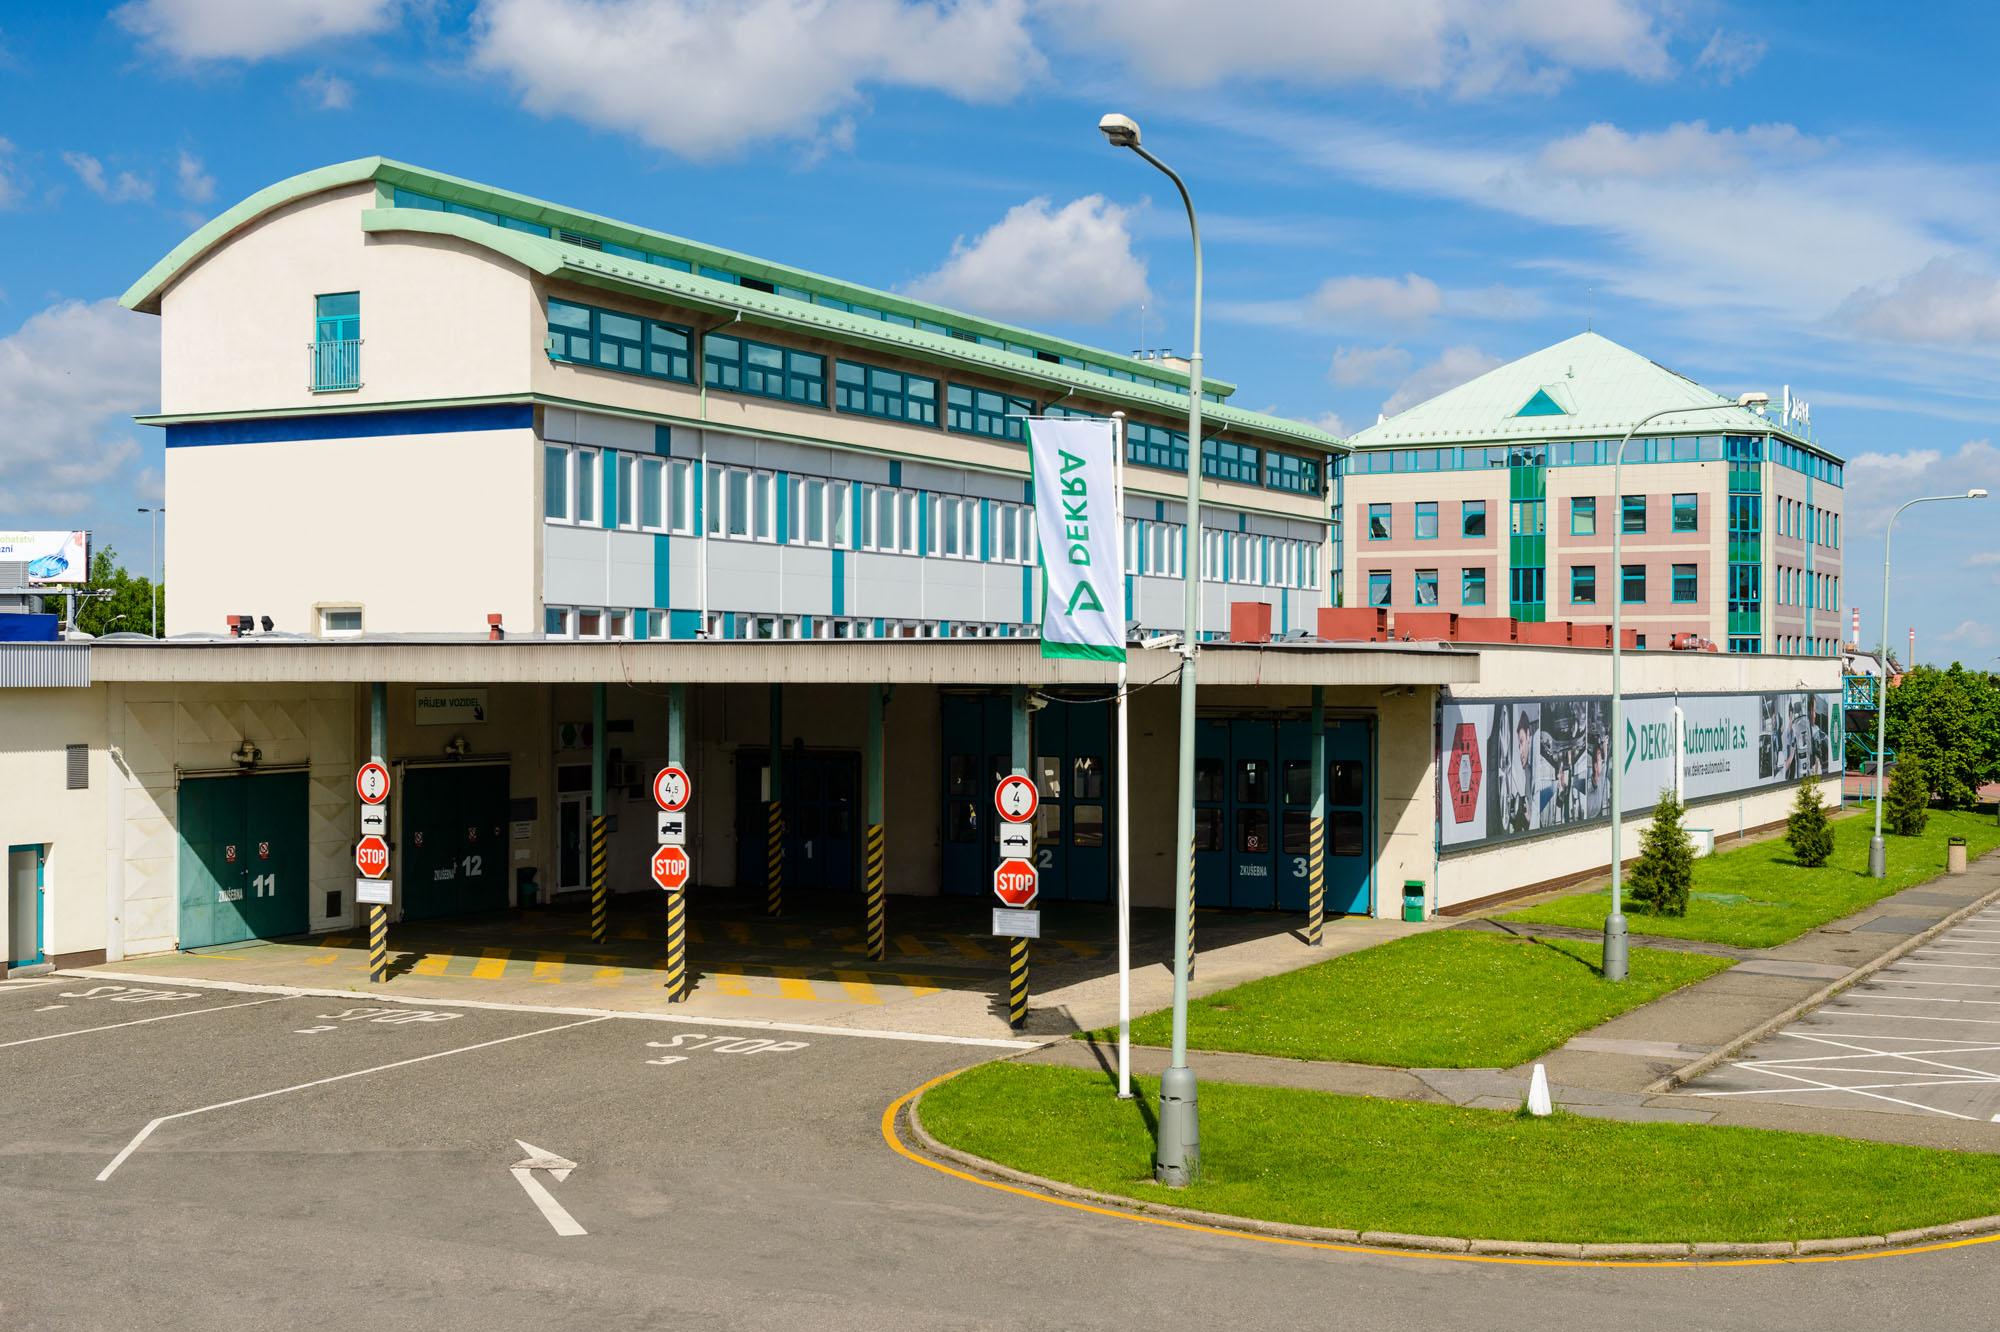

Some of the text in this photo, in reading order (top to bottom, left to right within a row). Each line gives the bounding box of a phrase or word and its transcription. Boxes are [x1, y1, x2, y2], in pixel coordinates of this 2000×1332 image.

[0, 544, 14, 553] zní
[418, 696, 480, 708] PŘÍJEM VOZIDEL
[1641, 720, 1676, 761] DEKRA
[1733, 723, 1748, 750] a.s.
[370, 776, 376, 788] 3
[1013, 791, 1020, 803] 4
[360, 848, 385, 864] STOP
[805, 840, 812, 859] 1
[462, 855, 482, 877] 12
[656, 859, 685, 876] STOP
[1039, 849, 1053, 869] 2
[1292, 857, 1308, 878] 3
[1240, 863, 1267, 876] ZKUŠEBNA
[253, 873, 275, 897] 11
[999, 873, 1033, 892] STOP
[59, 986, 202, 1003] STOP
[316, 1008, 465, 1025] STOP
[645, 1033, 810, 1055] STOP
[645, 1055, 689, 1065] 3
